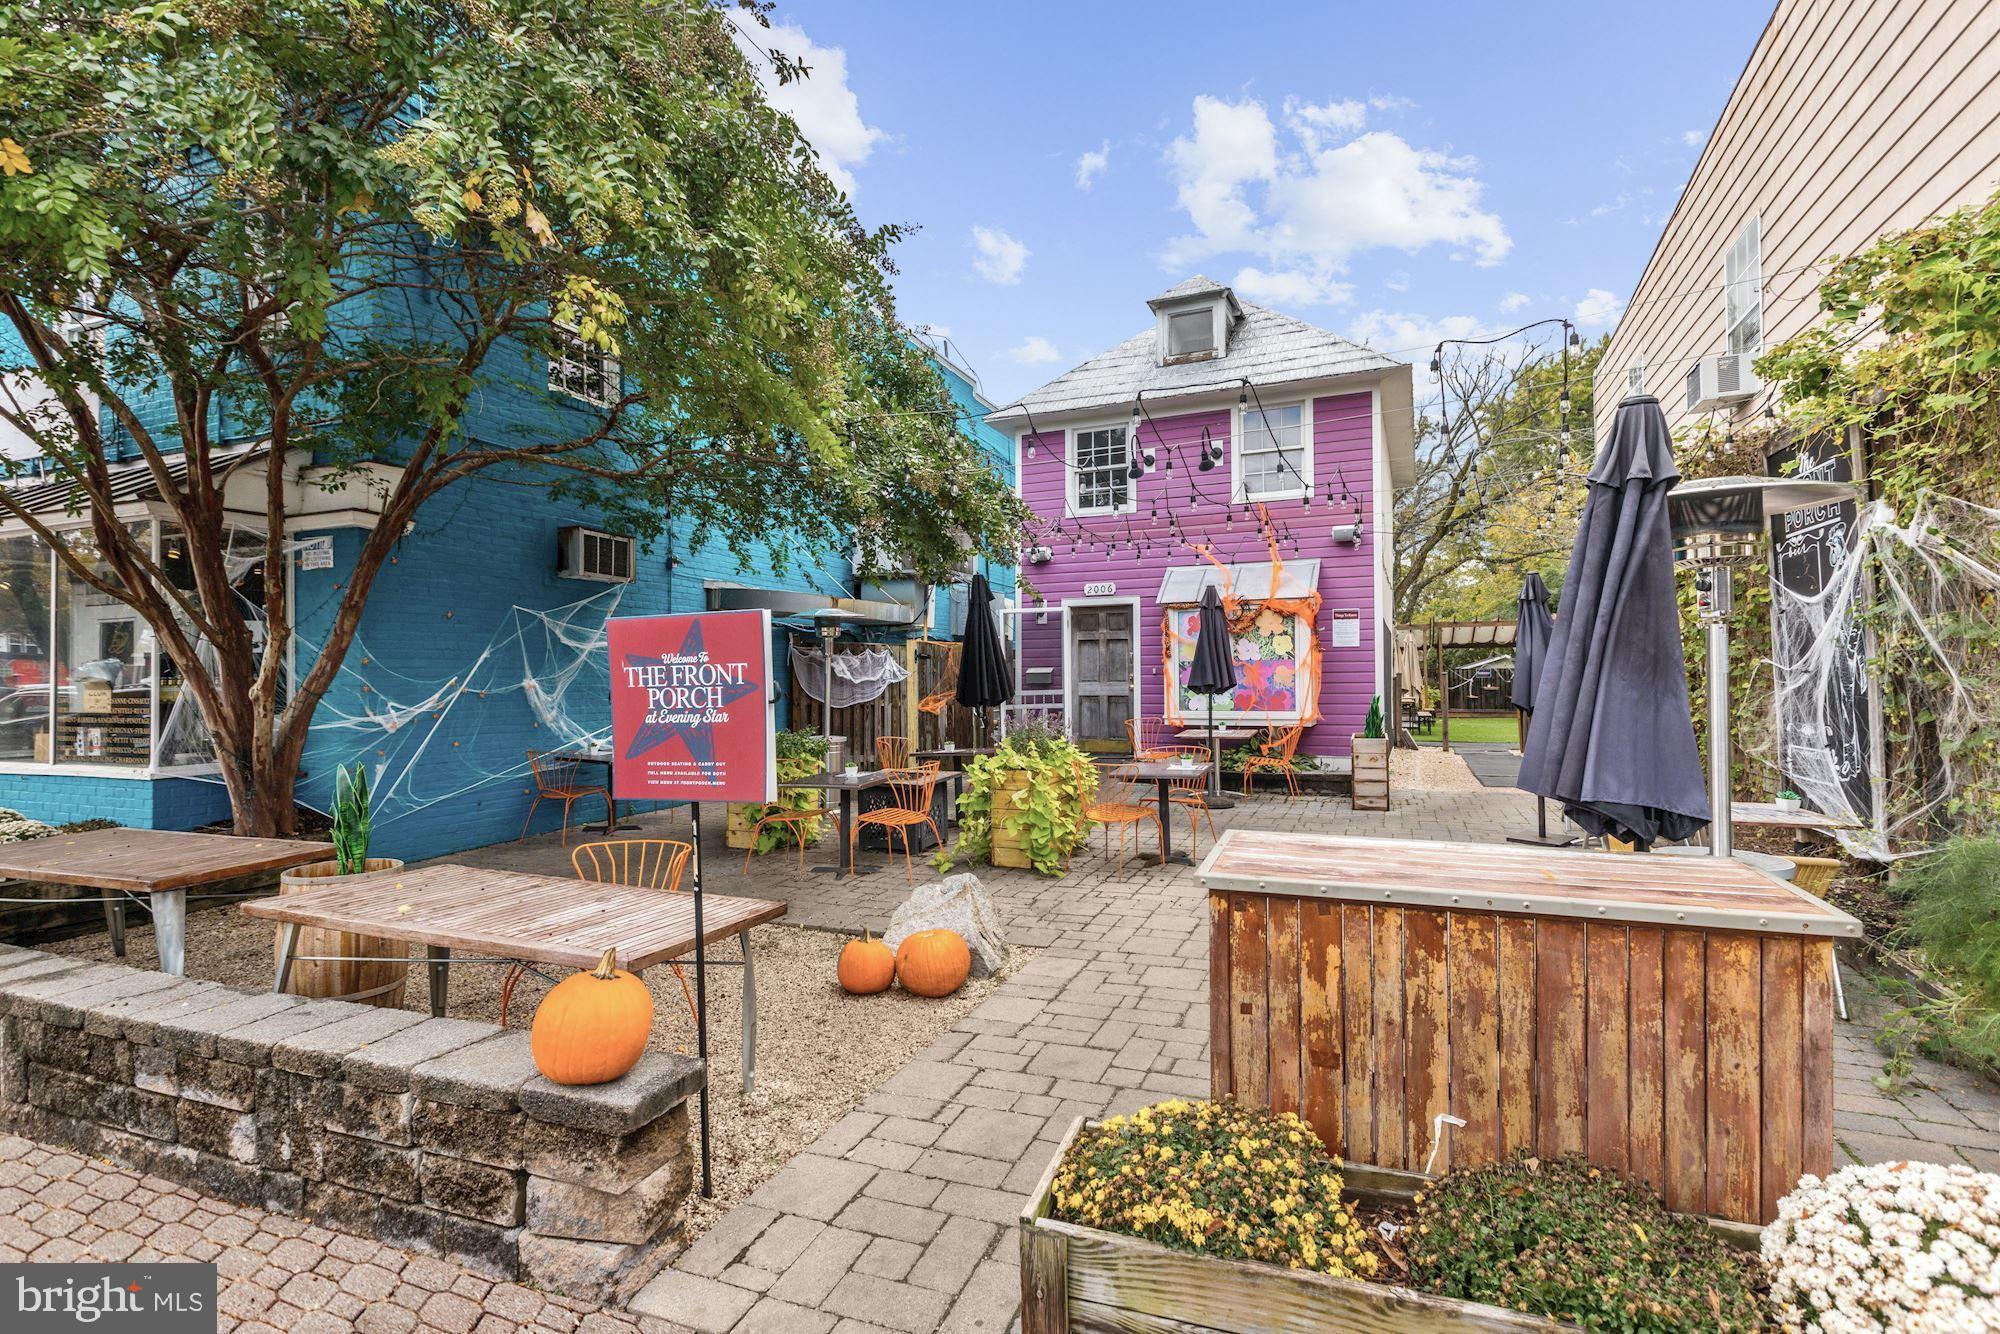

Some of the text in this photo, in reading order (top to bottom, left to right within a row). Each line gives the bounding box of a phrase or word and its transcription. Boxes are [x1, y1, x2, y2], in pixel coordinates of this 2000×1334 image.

[1798, 452, 1816, 472] The
[1784, 502, 1841, 533] PORCH
[1088, 584, 1113, 593] 2006
[661, 651, 709, 664] Welcome To
[623, 663, 748, 688] THE FRONT
[647, 686, 724, 709] PORCH
[645, 708, 729, 728] at Evening Star
